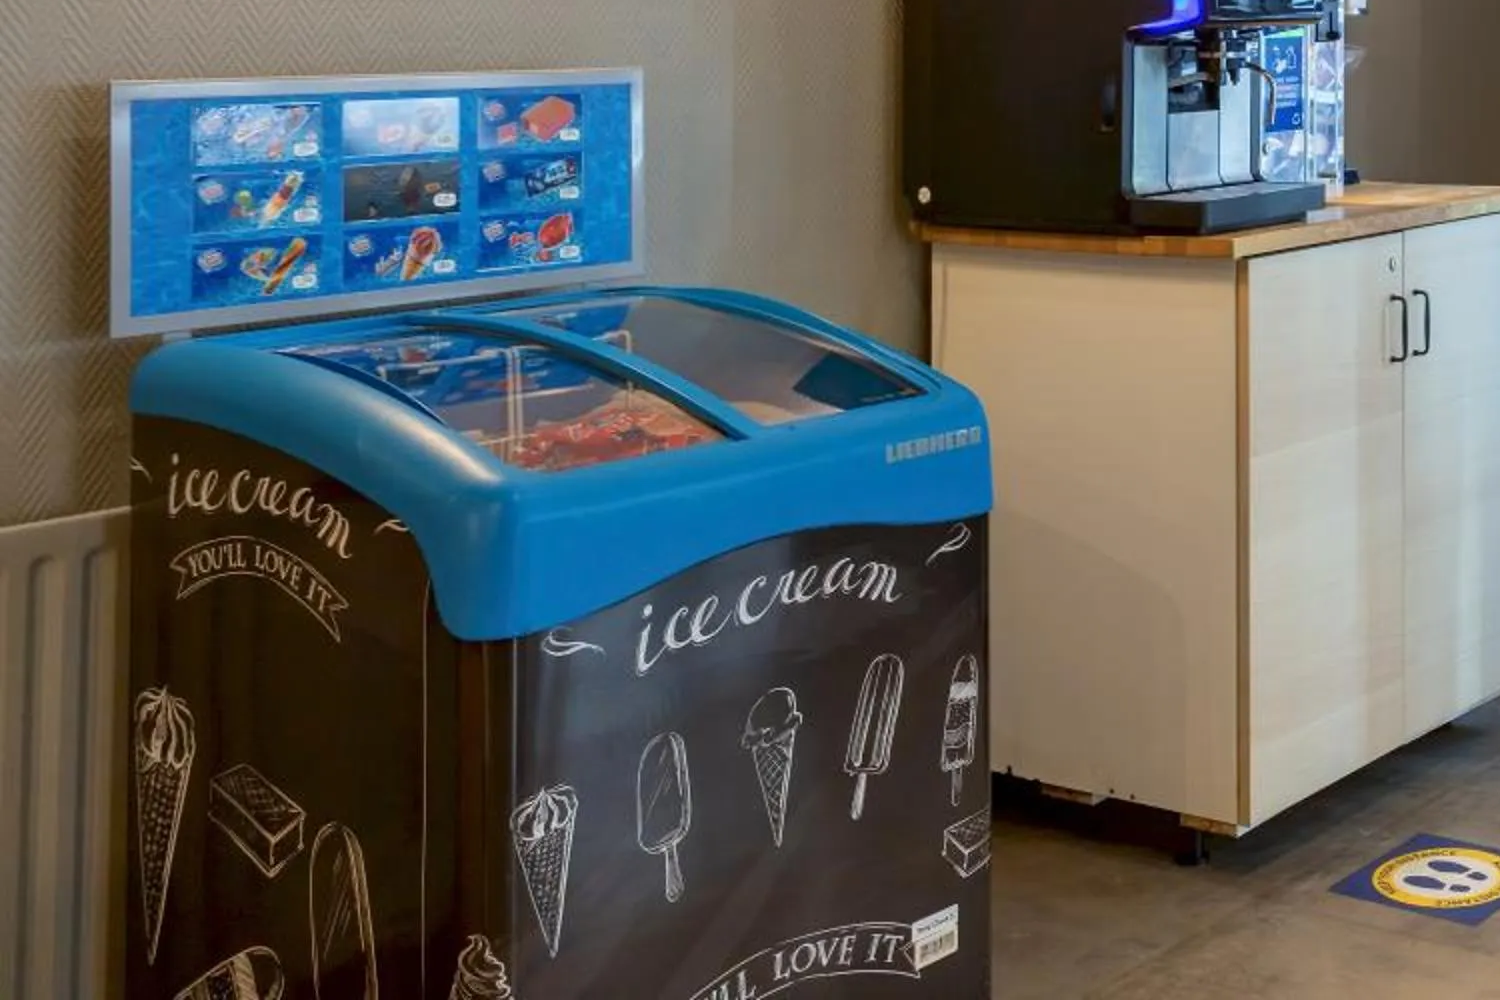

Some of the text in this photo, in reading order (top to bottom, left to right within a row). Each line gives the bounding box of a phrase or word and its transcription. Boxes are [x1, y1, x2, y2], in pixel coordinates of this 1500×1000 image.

[886, 425, 982, 465] LIEBHERR
[188, 542, 333, 613] YOU'LL LOVE IT
[772, 934, 857, 982] LOVE
[864, 932, 905, 964] IT
